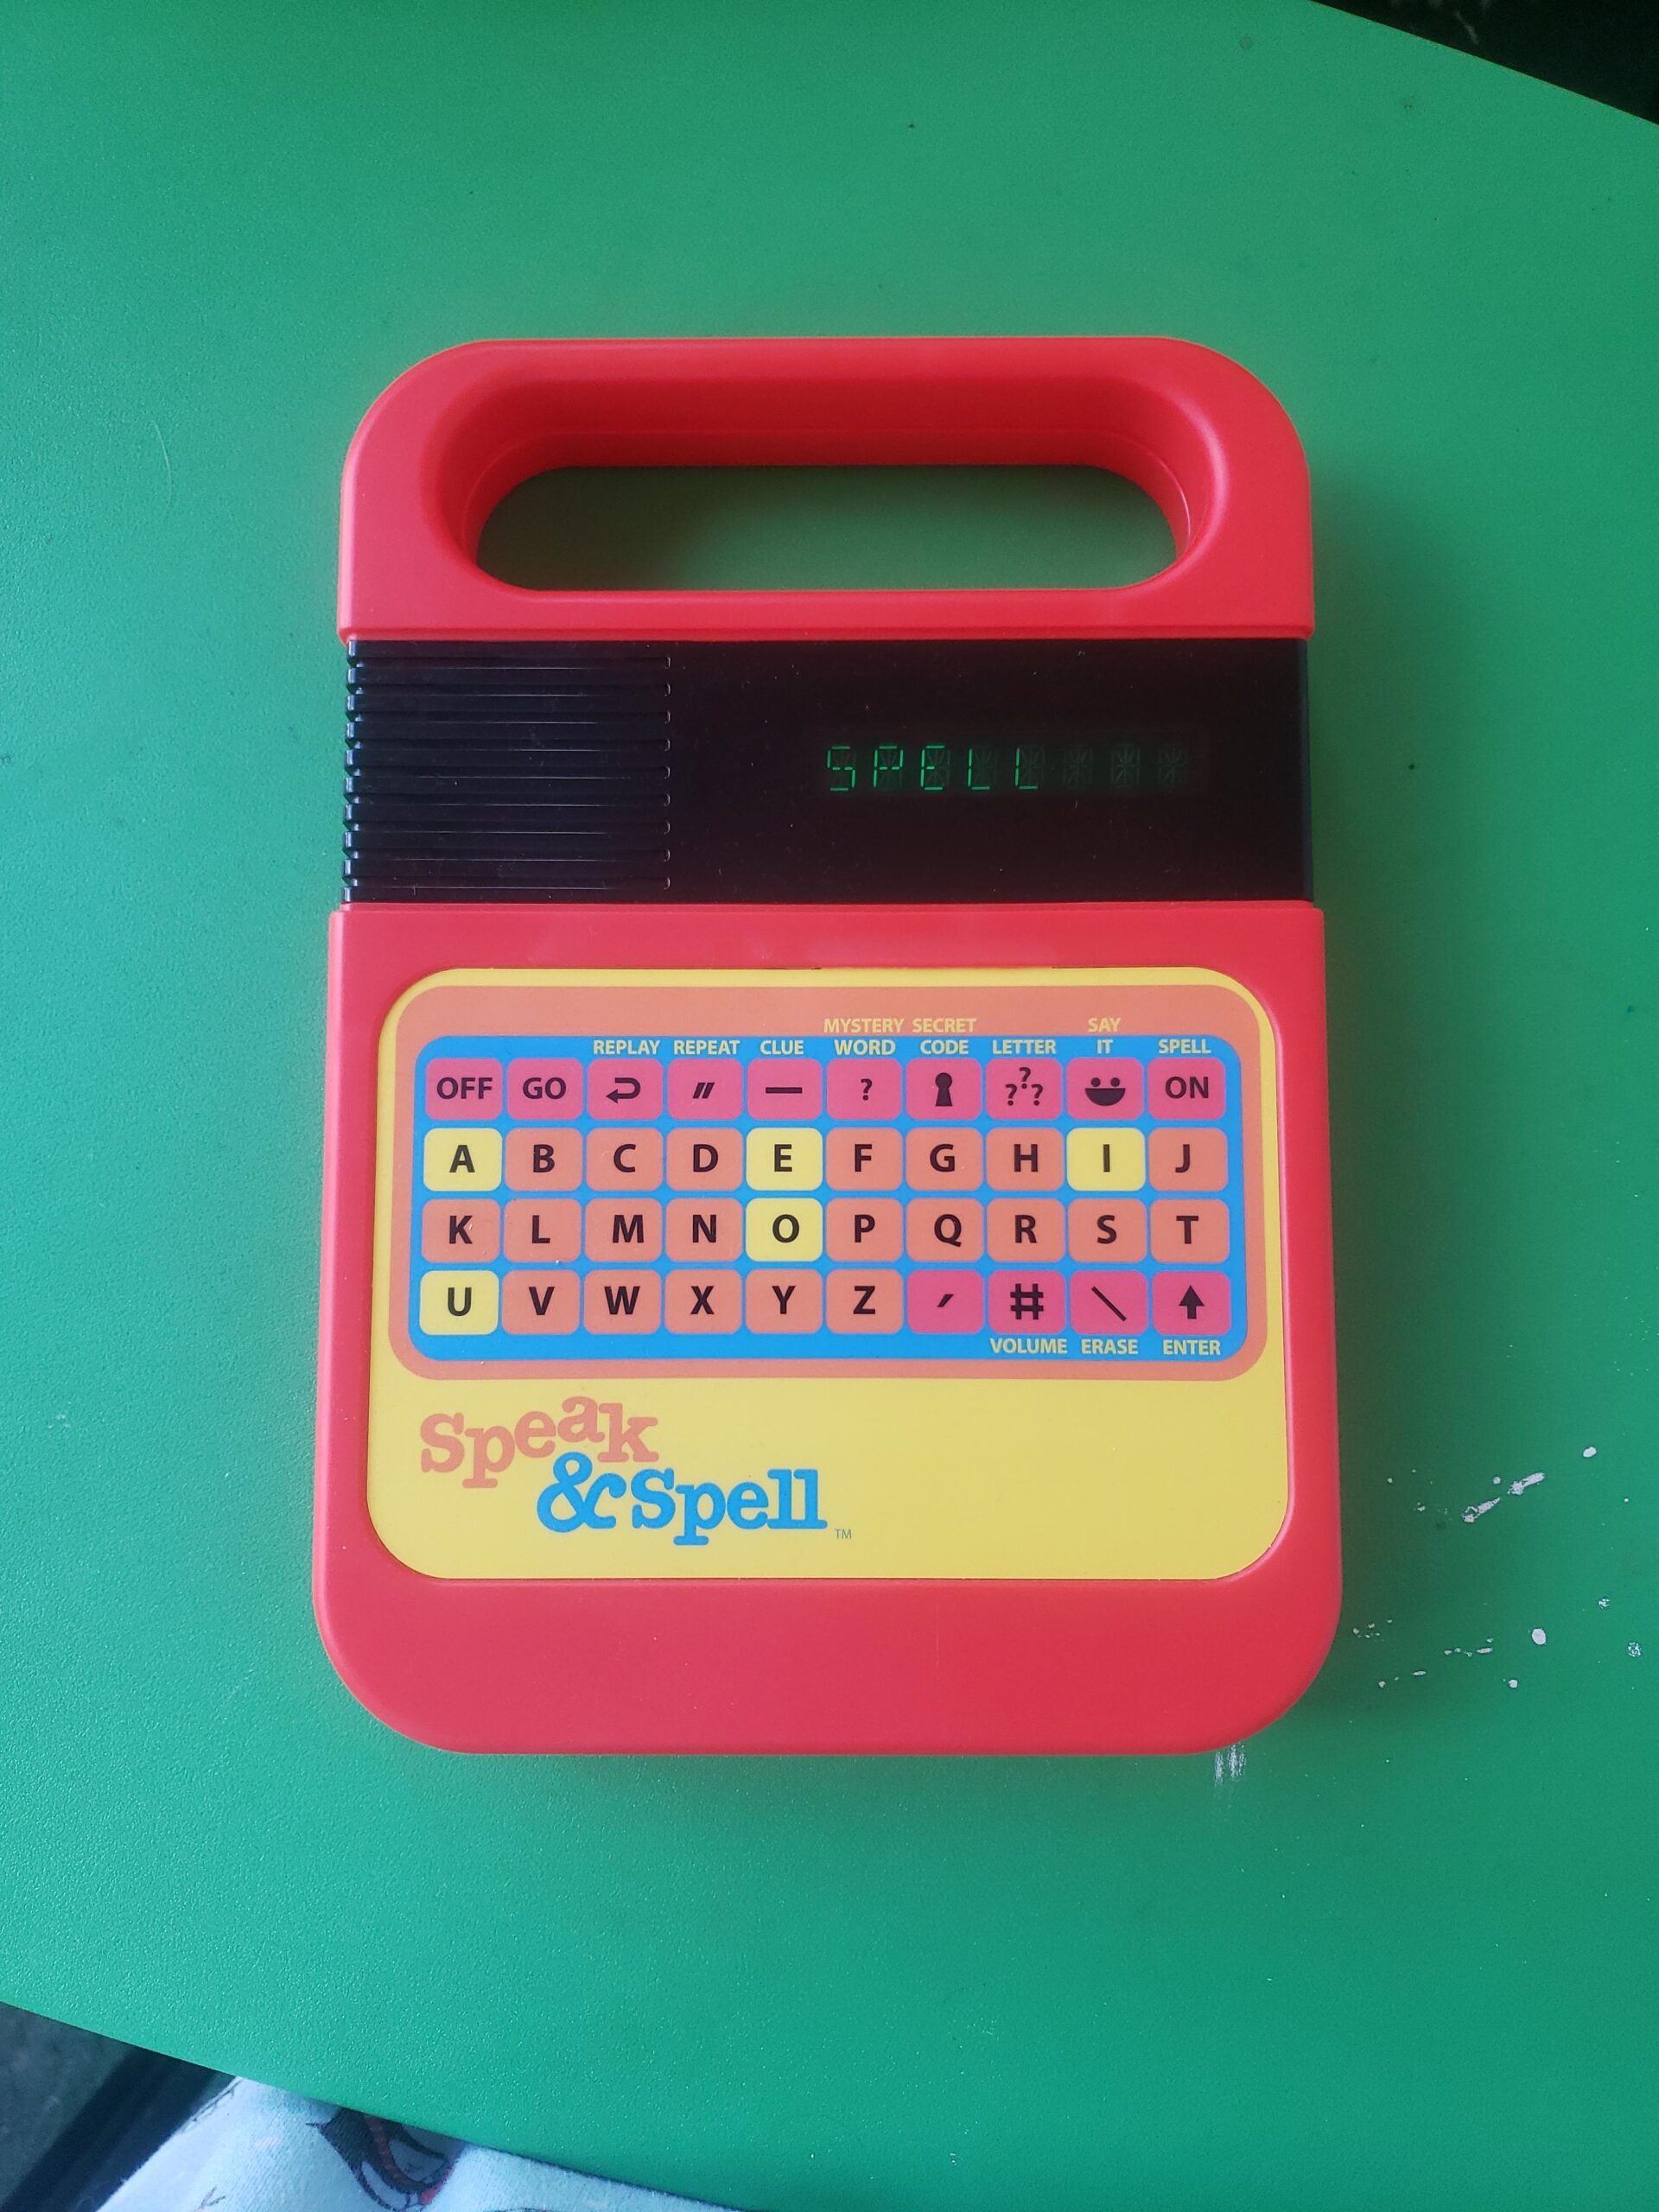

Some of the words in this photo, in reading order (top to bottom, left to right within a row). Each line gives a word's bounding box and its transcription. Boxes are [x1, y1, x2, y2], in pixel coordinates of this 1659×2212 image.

[826, 744, 1038, 791] SPELL
[823, 1018, 905, 1033] MYSTERY
[912, 1018, 976, 1033] SECRET
[1087, 1018, 1122, 1032] SAY
[594, 1040, 661, 1055] REPLAY
[674, 1040, 741, 1055] REPEAT
[760, 1040, 804, 1055] CLUE
[834, 1039, 896, 1055] WORD
[920, 1039, 969, 1054] CODE
[992, 1039, 1057, 1054] LETTER
[1096, 1039, 1113, 1054] IT
[1158, 1039, 1211, 1054] SPELL
[436, 1077, 493, 1099] OFF
[522, 1077, 567, 1099] GO
[1165, 1077, 1210, 1099] ON
[448, 1145, 475, 1173] A
[533, 1144, 556, 1173] B
[613, 1143, 636, 1173] C
[693, 1144, 719, 1172] D
[774, 1144, 792, 1172] E
[854, 1144, 873, 1173] F
[930, 1143, 956, 1173] G
[1014, 1144, 1039, 1173] H
[1103, 1144, 1110, 1173] I
[1175, 1144, 1191, 1173] J
[448, 1215, 473, 1244] K
[531, 1215, 550, 1243] L
[612, 1214, 645, 1243] M
[692, 1214, 717, 1243] N
[772, 1214, 800, 1243] O
[854, 1215, 876, 1243] P
[933, 1215, 963, 1248] Q
[1014, 1215, 1037, 1243] R
[1096, 1215, 1117, 1244] S
[1176, 1215, 1199, 1244] T
[447, 1287, 473, 1317] U
[529, 1287, 555, 1315] V
[604, 1286, 640, 1314] W
[690, 1286, 715, 1314] X
[771, 1286, 797, 1314] Y
[853, 1286, 876, 1315] Z
[989, 1338, 1068, 1354] VOLUME
[1081, 1339, 1138, 1355] ERASE
[1163, 1340, 1221, 1356] ENTER
[419, 1395, 659, 1489] Speak
[537, 1452, 627, 1534] &
[631, 1467, 828, 1546] Spell
[835, 1529, 852, 1540] TM
